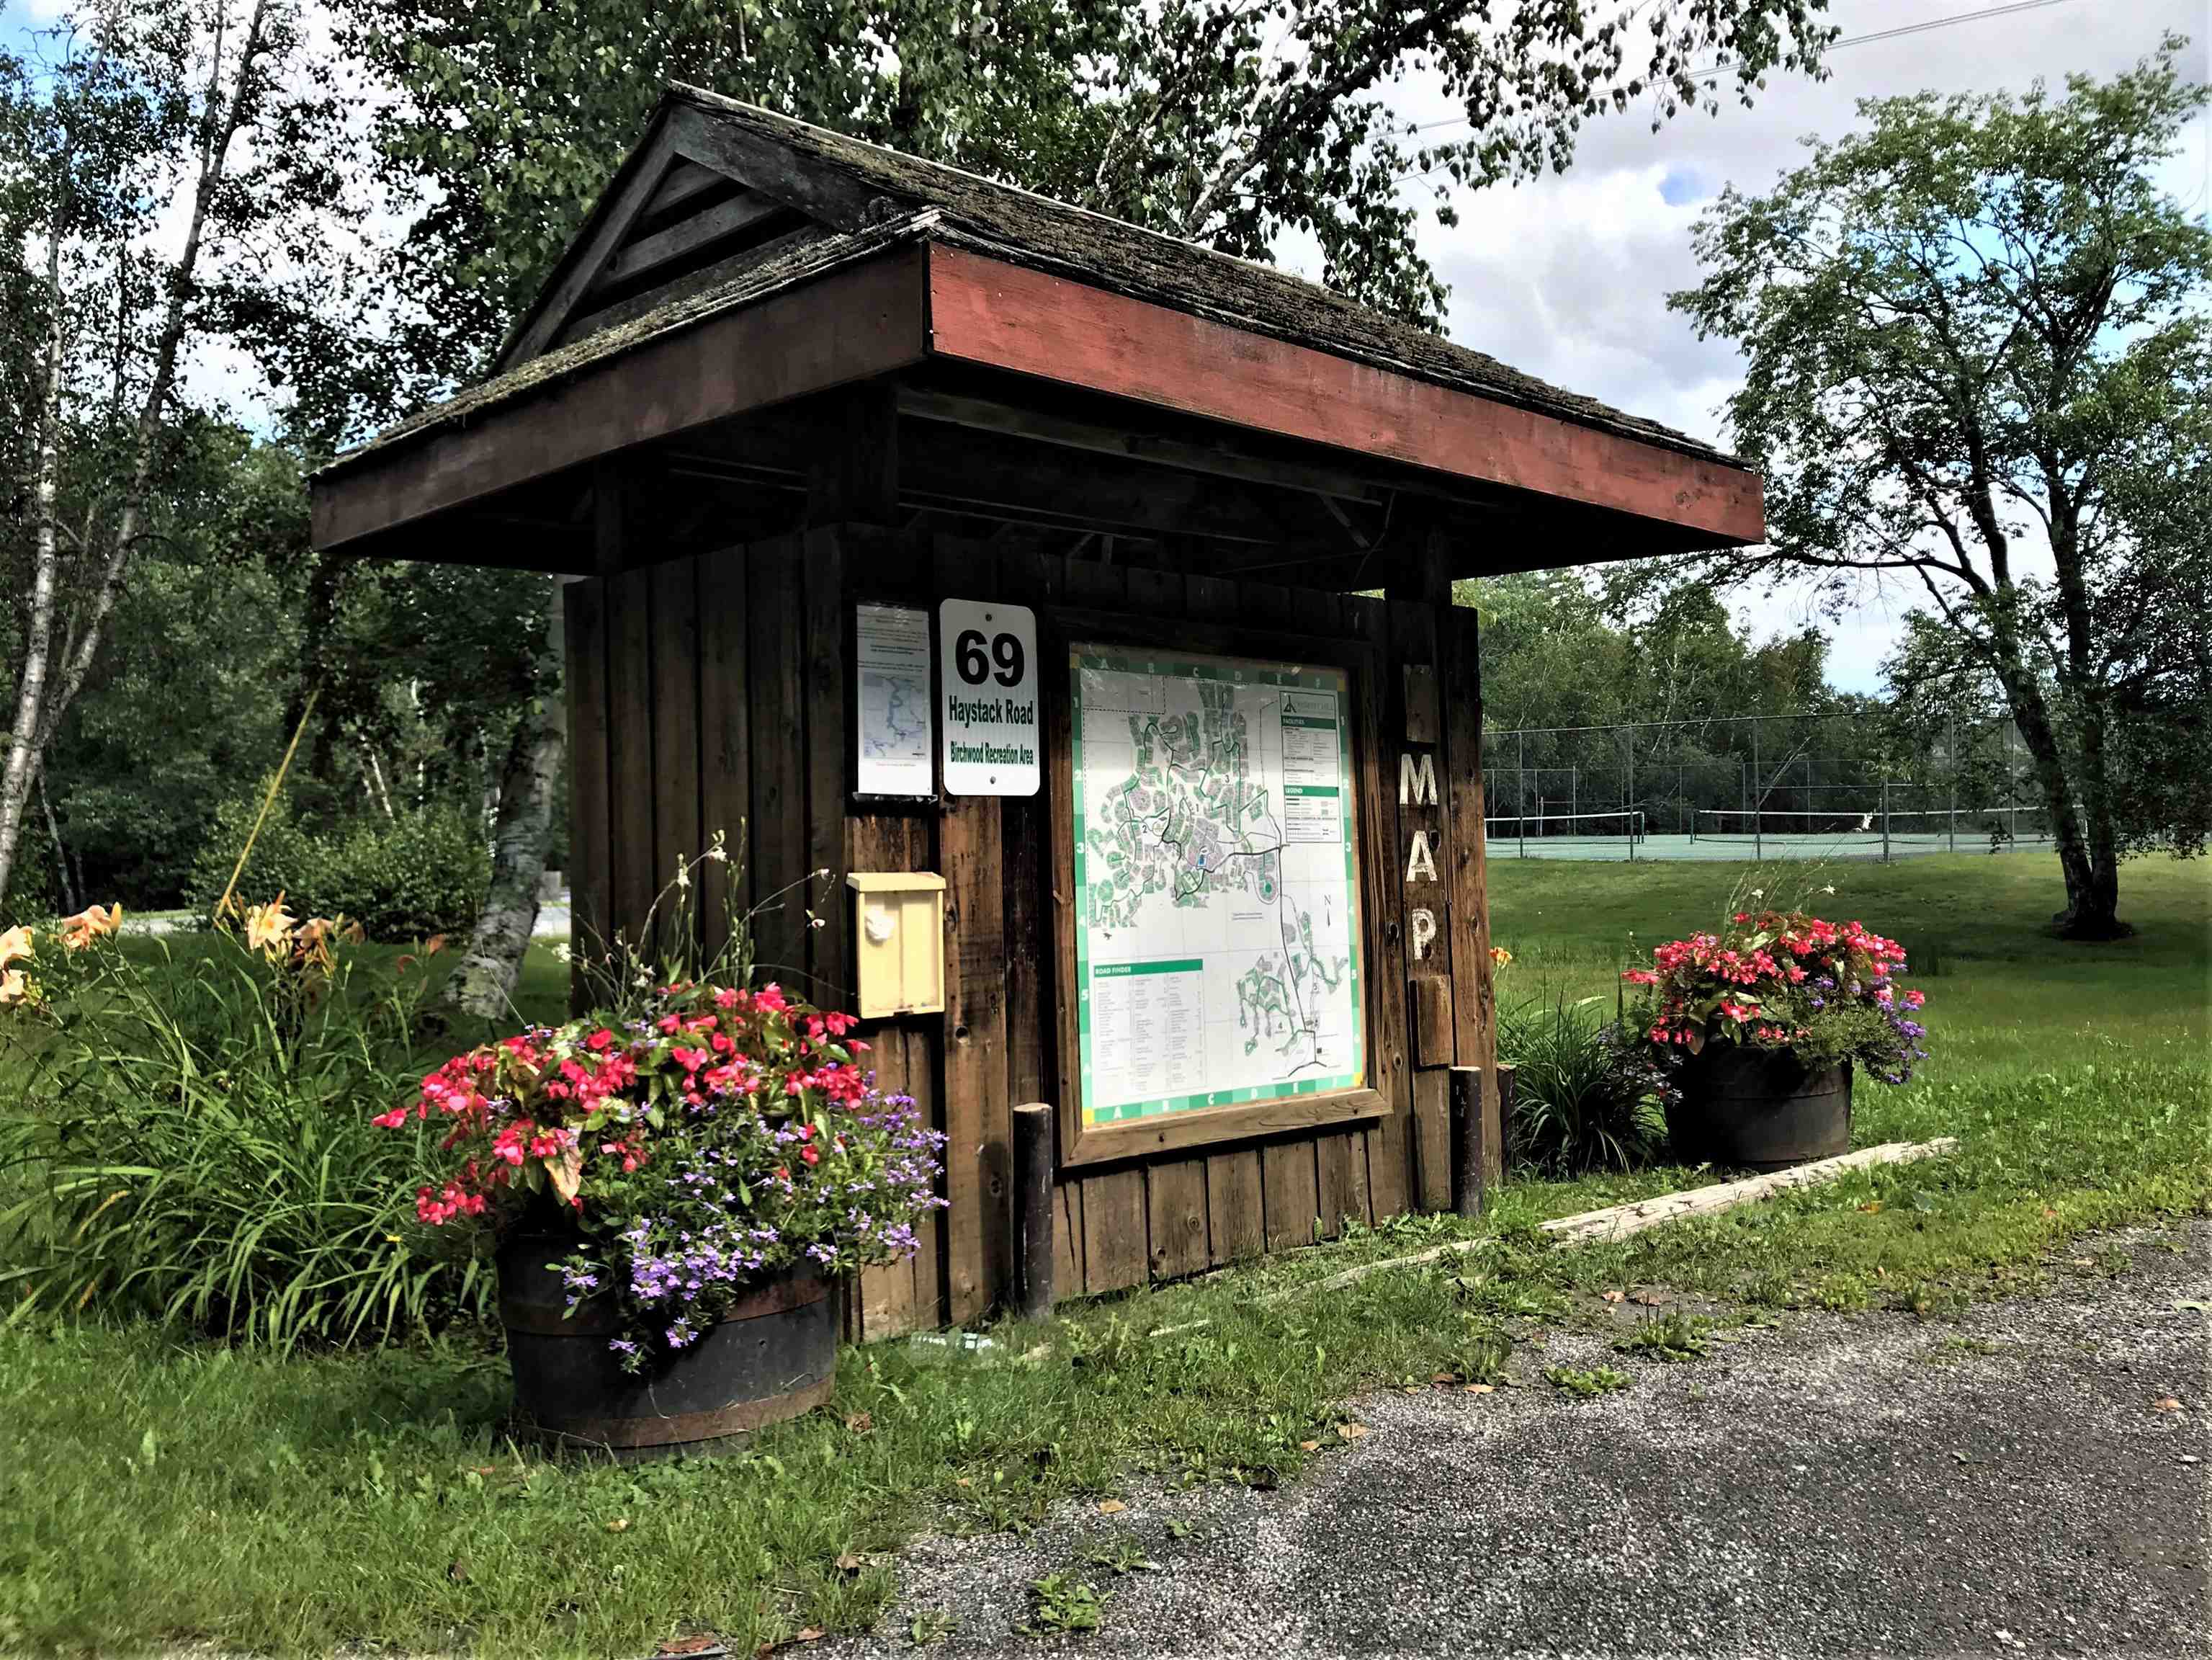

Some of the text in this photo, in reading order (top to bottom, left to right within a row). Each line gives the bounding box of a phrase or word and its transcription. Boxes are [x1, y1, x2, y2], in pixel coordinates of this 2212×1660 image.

[955, 629, 1025, 688] 69
[949, 695, 1034, 728] Haystack Road
[950, 741, 1034, 765] Birchwood Recreation Area
[1076, 842, 1085, 854] 3
[1345, 842, 1352, 852] 3
[1400, 754, 1438, 960] MAP
[1081, 990, 1090, 1001] 5
[1113, 1106, 1123, 1120] A
[1208, 1094, 1215, 1105] C
